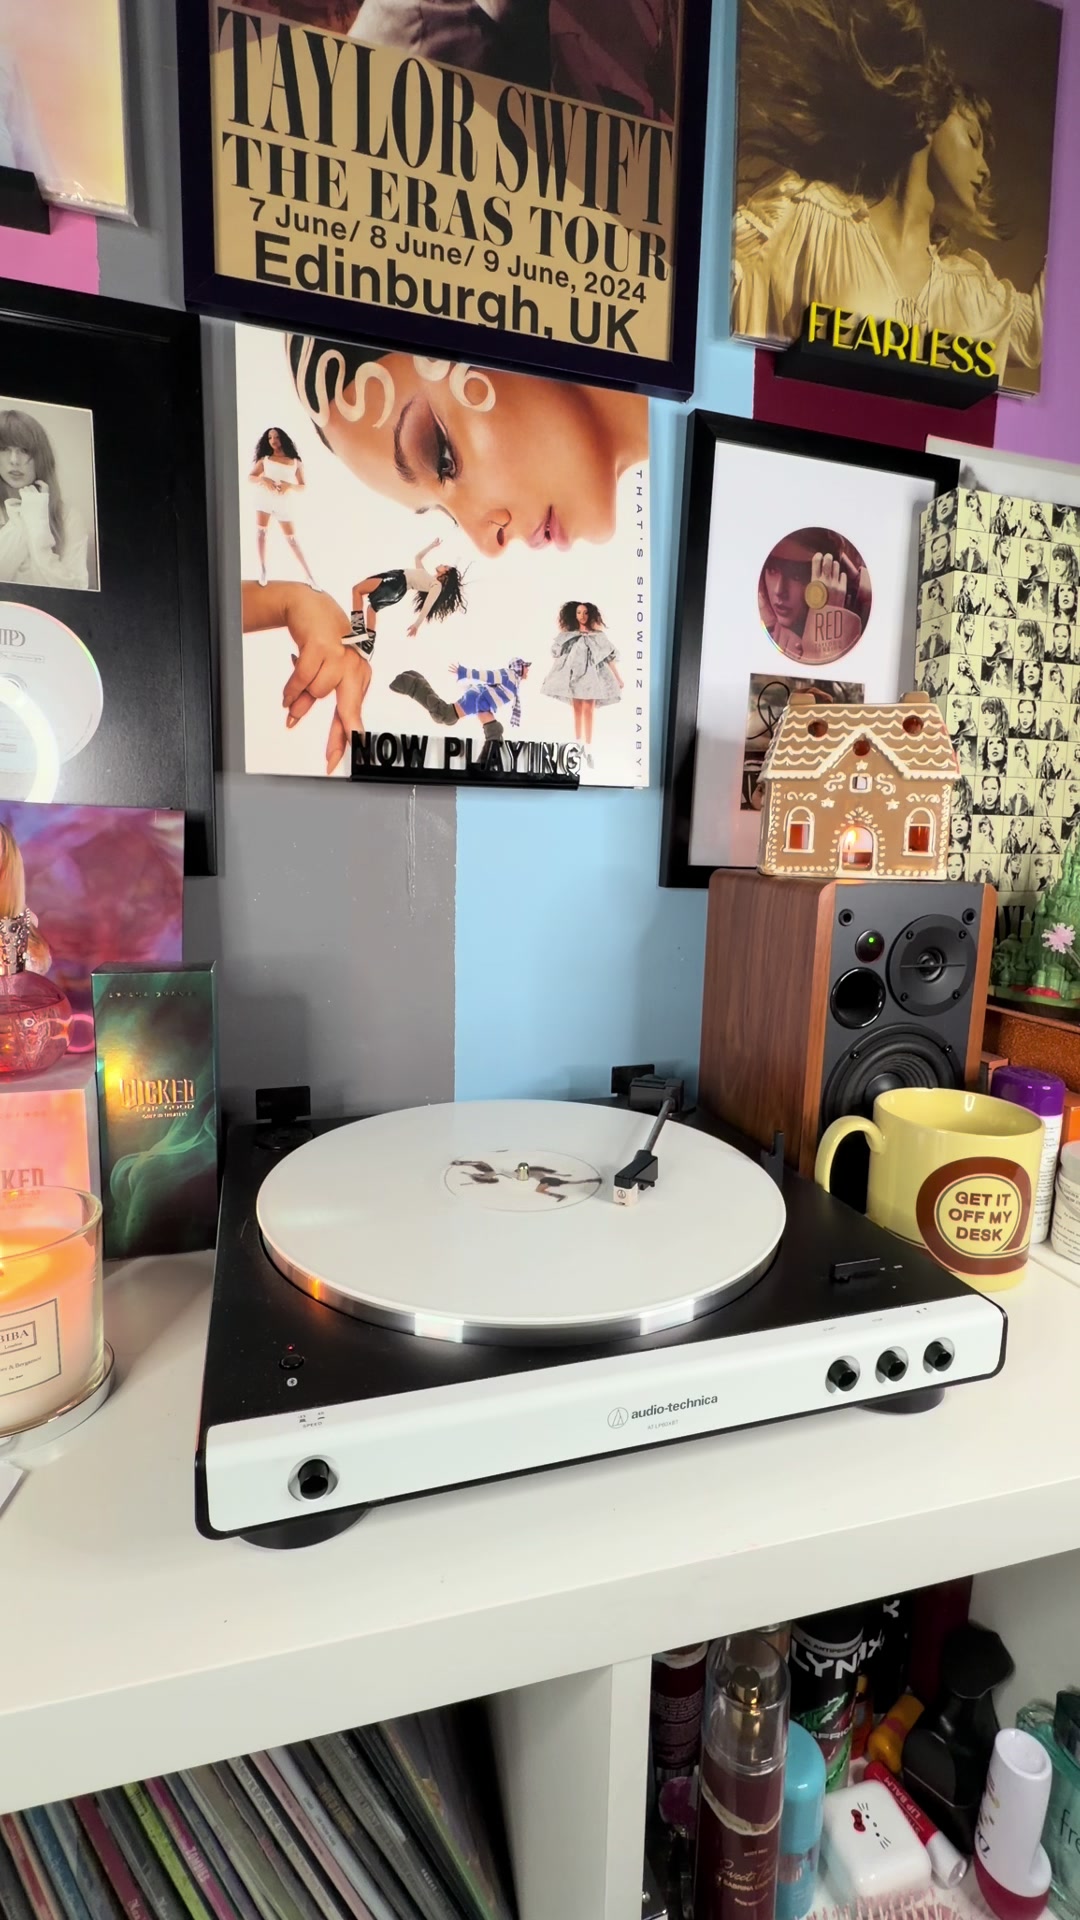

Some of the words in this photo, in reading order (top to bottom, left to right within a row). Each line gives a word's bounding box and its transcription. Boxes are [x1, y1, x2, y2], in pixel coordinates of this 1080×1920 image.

[218, 9, 478, 182] TAYLOR
[495, 86, 673, 226] SWIFT
[222, 131, 349, 212] THE
[366, 166, 513, 247] ERAS
[529, 205, 669, 282] TOUR
[249, 197, 266, 222] 7
[275, 203, 361, 245] June/
[370, 225, 388, 250] 8
[395, 233, 475, 268] June/
[484, 249, 500, 273] 9
[508, 256, 577, 294] June,
[584, 271, 647, 304] 2024
[254, 230, 554, 340] Edinburgh,
[569, 296, 639, 354] UK
[808, 301, 998, 378] FEARLESS
[635, 469, 645, 559] THAT'S
[635, 575, 645, 690] SHOWBIZ
[815, 610, 843, 642] RED
[351, 730, 429, 769] NOW
[444, 736, 583, 777] PLAYING
[120, 1078, 195, 1109] WICKED
[948, 1208, 985, 1223] OFF
[989, 1210, 1012, 1224] MY
[955, 1191, 993, 1206] GET
[996, 1193, 1011, 1207] IT
[955, 1226, 1003, 1241] DESK
[631, 1395, 718, 1419] audio-technica
[791, 1638, 861, 1680] LYN
[883, 1776, 908, 1804] BALM
[906, 1803, 921, 1819] LIP
